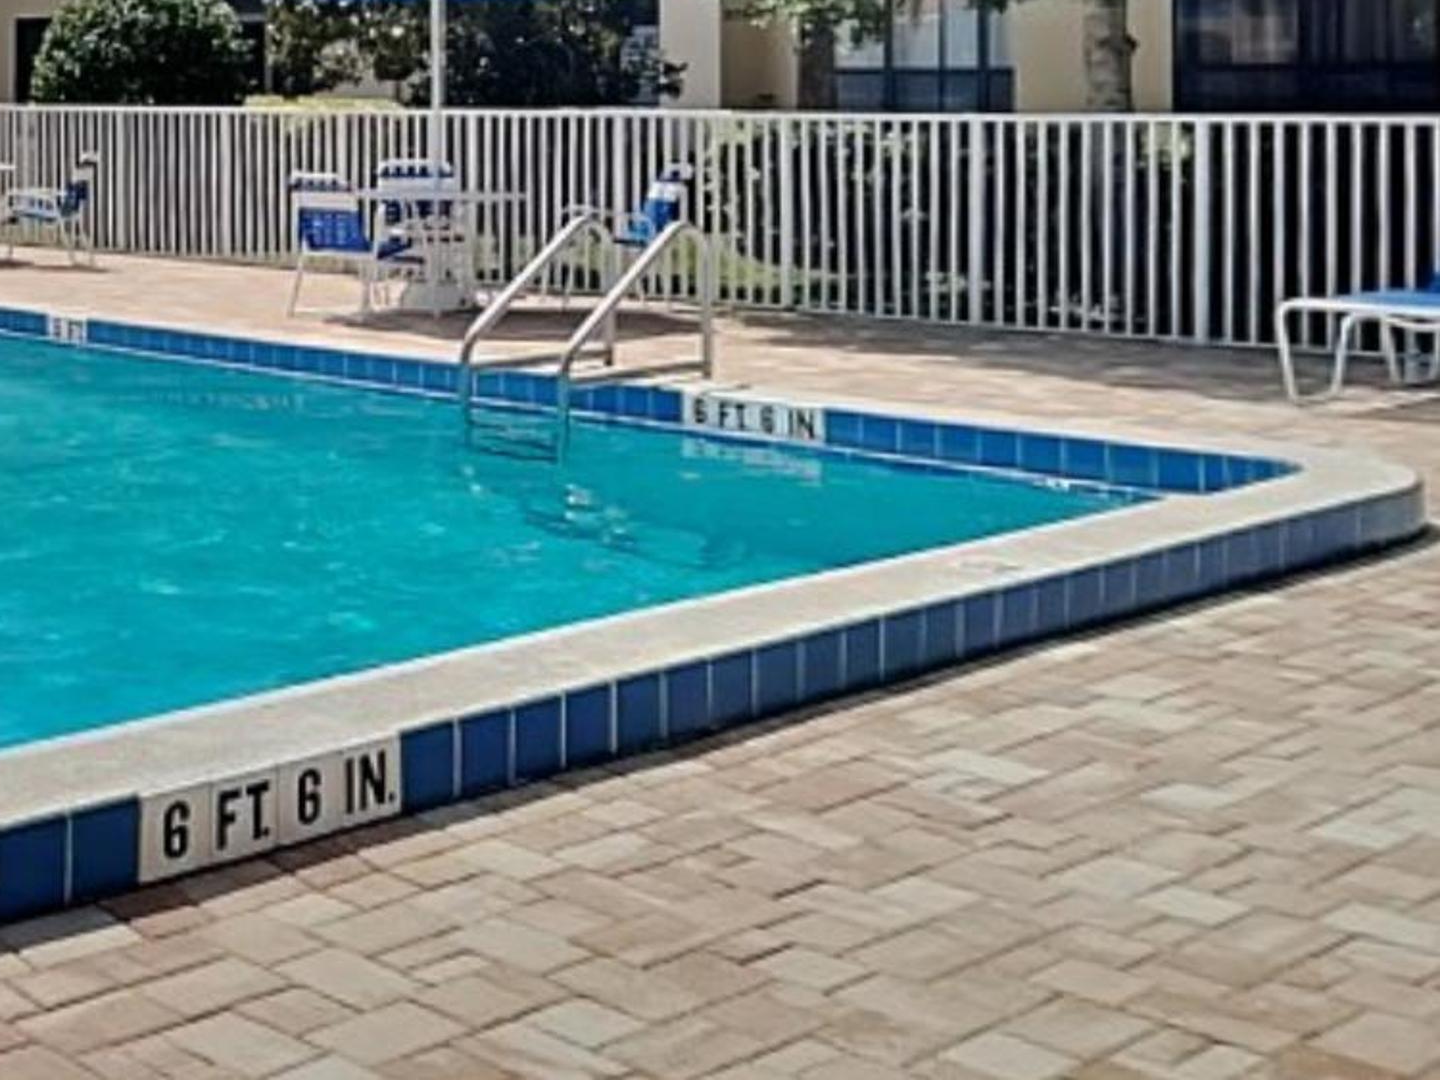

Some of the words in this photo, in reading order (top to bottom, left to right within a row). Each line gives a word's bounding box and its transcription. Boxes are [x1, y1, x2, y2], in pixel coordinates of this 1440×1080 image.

[163, 800, 190, 859] 6
[297, 768, 322, 826] 6
[343, 748, 396, 815] IN.
